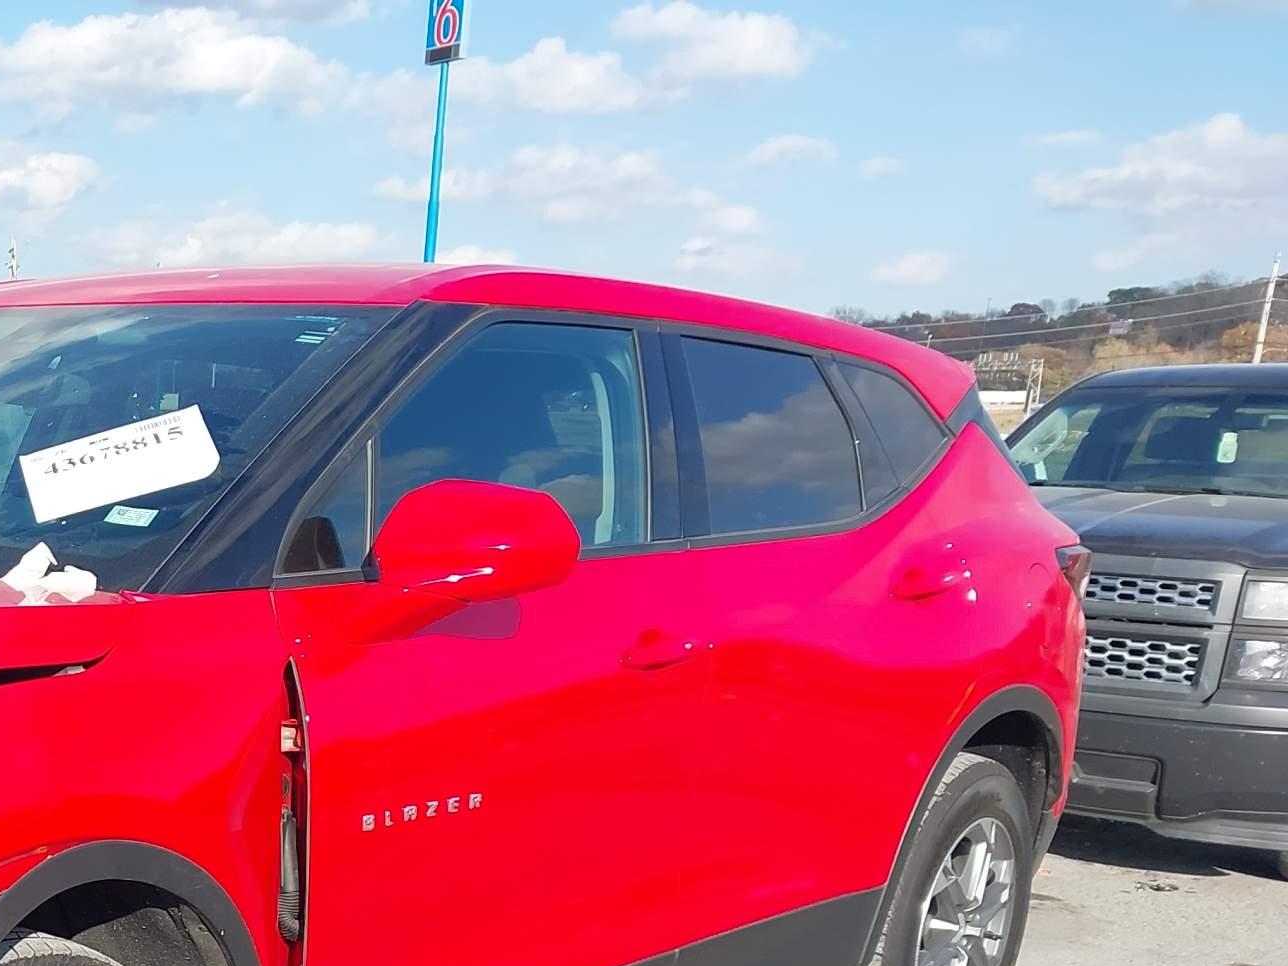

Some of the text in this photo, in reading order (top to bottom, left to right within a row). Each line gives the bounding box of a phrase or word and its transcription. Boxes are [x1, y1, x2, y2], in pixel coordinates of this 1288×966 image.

[434, 0, 459, 47] 6
[44, 426, 184, 474] 43678815
[362, 793, 482, 831] BLAZER
